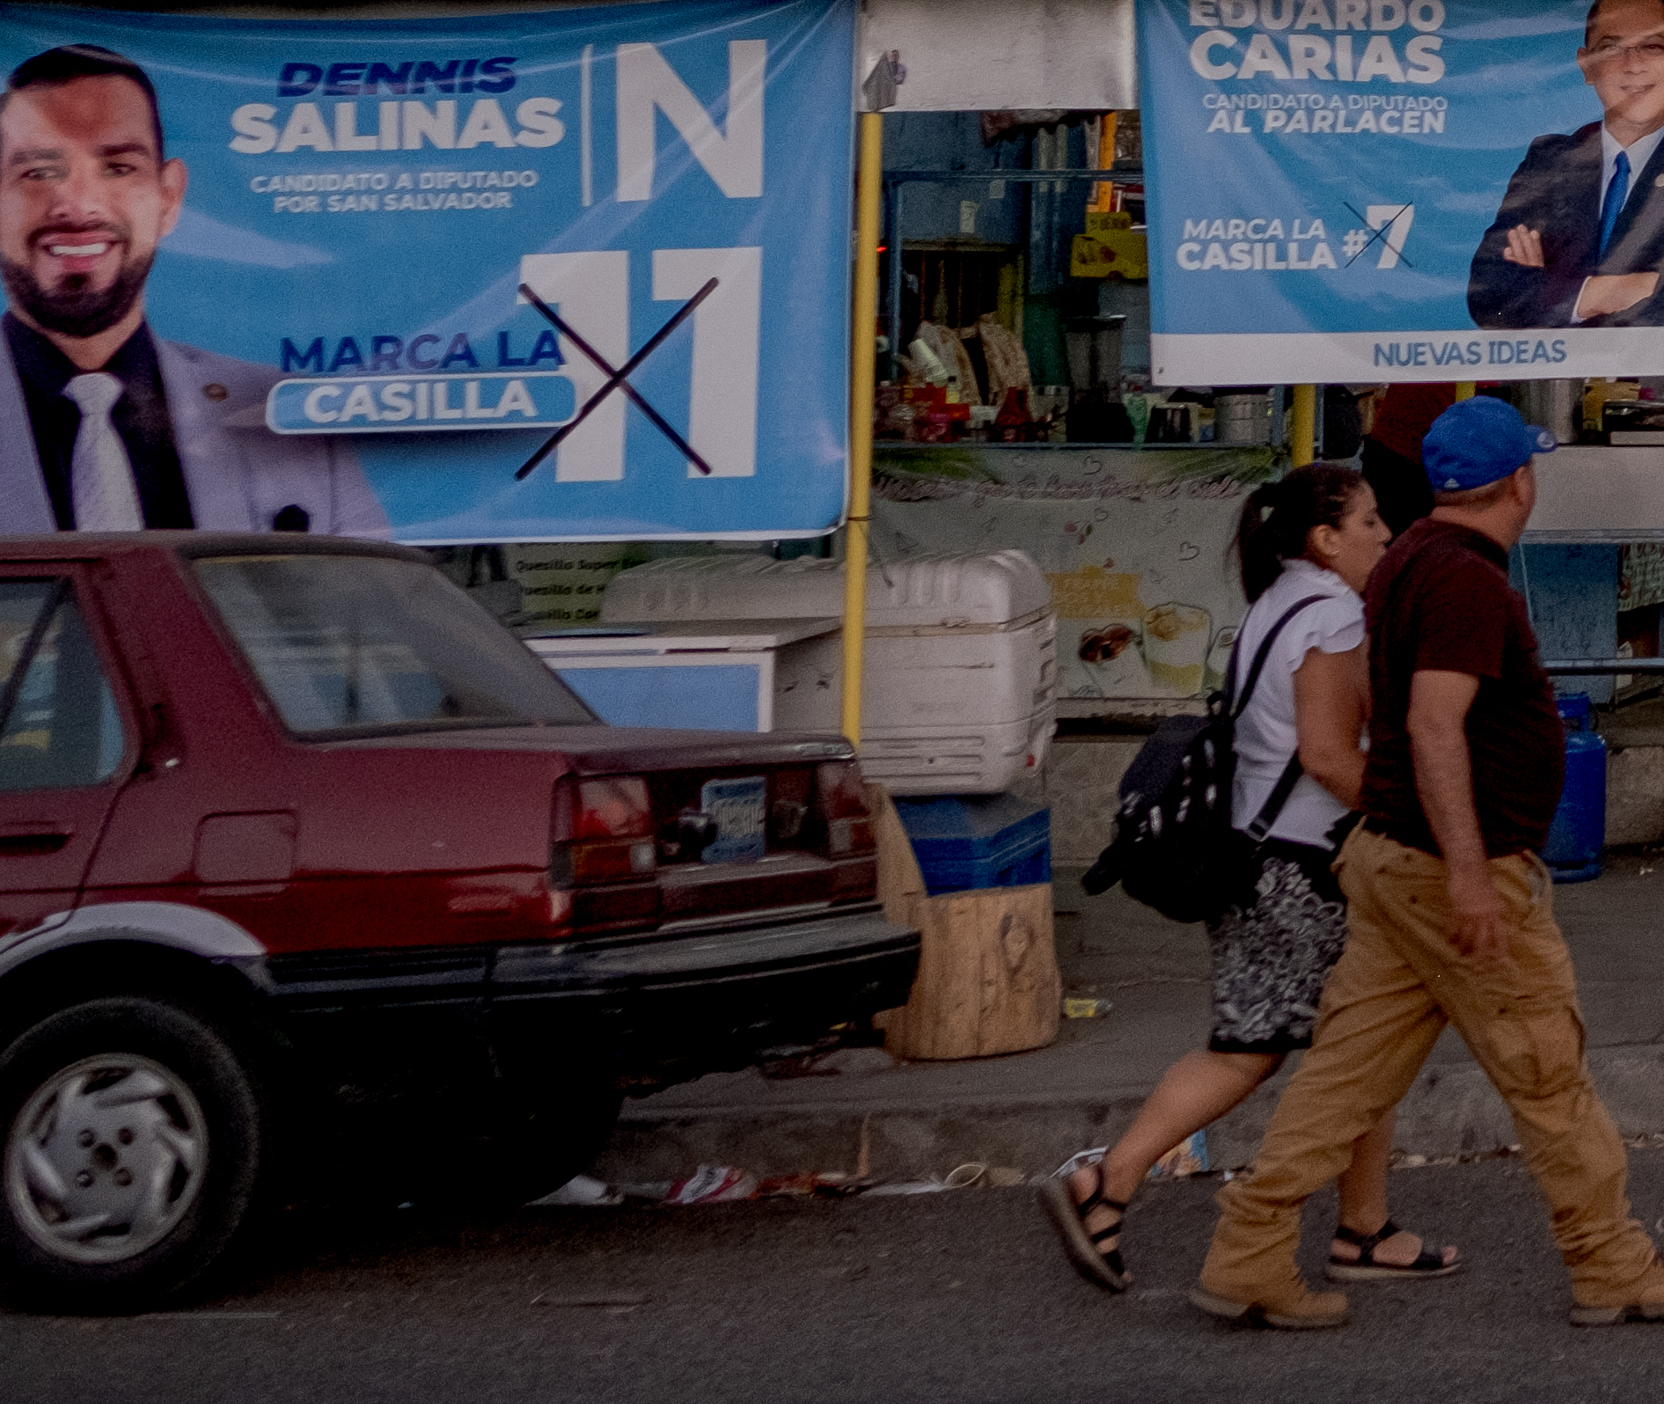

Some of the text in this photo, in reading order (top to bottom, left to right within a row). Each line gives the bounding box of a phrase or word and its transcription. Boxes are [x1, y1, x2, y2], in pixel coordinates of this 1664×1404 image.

[1189, 30, 1446, 84] CARIAS
[277, 57, 518, 97] DENNIS
[1203, 94, 1448, 111] CANDIDATO A DIPUTADO
[229, 97, 565, 154] SALINAS
[615, 40, 767, 201] N
[1206, 110, 1446, 134] AL PARLACEN
[250, 169, 539, 193] CANDIDATO A DIPUTADO
[273, 192, 512, 213] POR SAN SALVADOR
[1183, 218, 1326, 240] MARCA LA
[1176, 242, 1338, 270] CASILLA
[280, 330, 566, 373] MARCA LA
[1373, 339, 1567, 367] NUEVAS IDEAS
[304, 379, 539, 424] CASILLA
